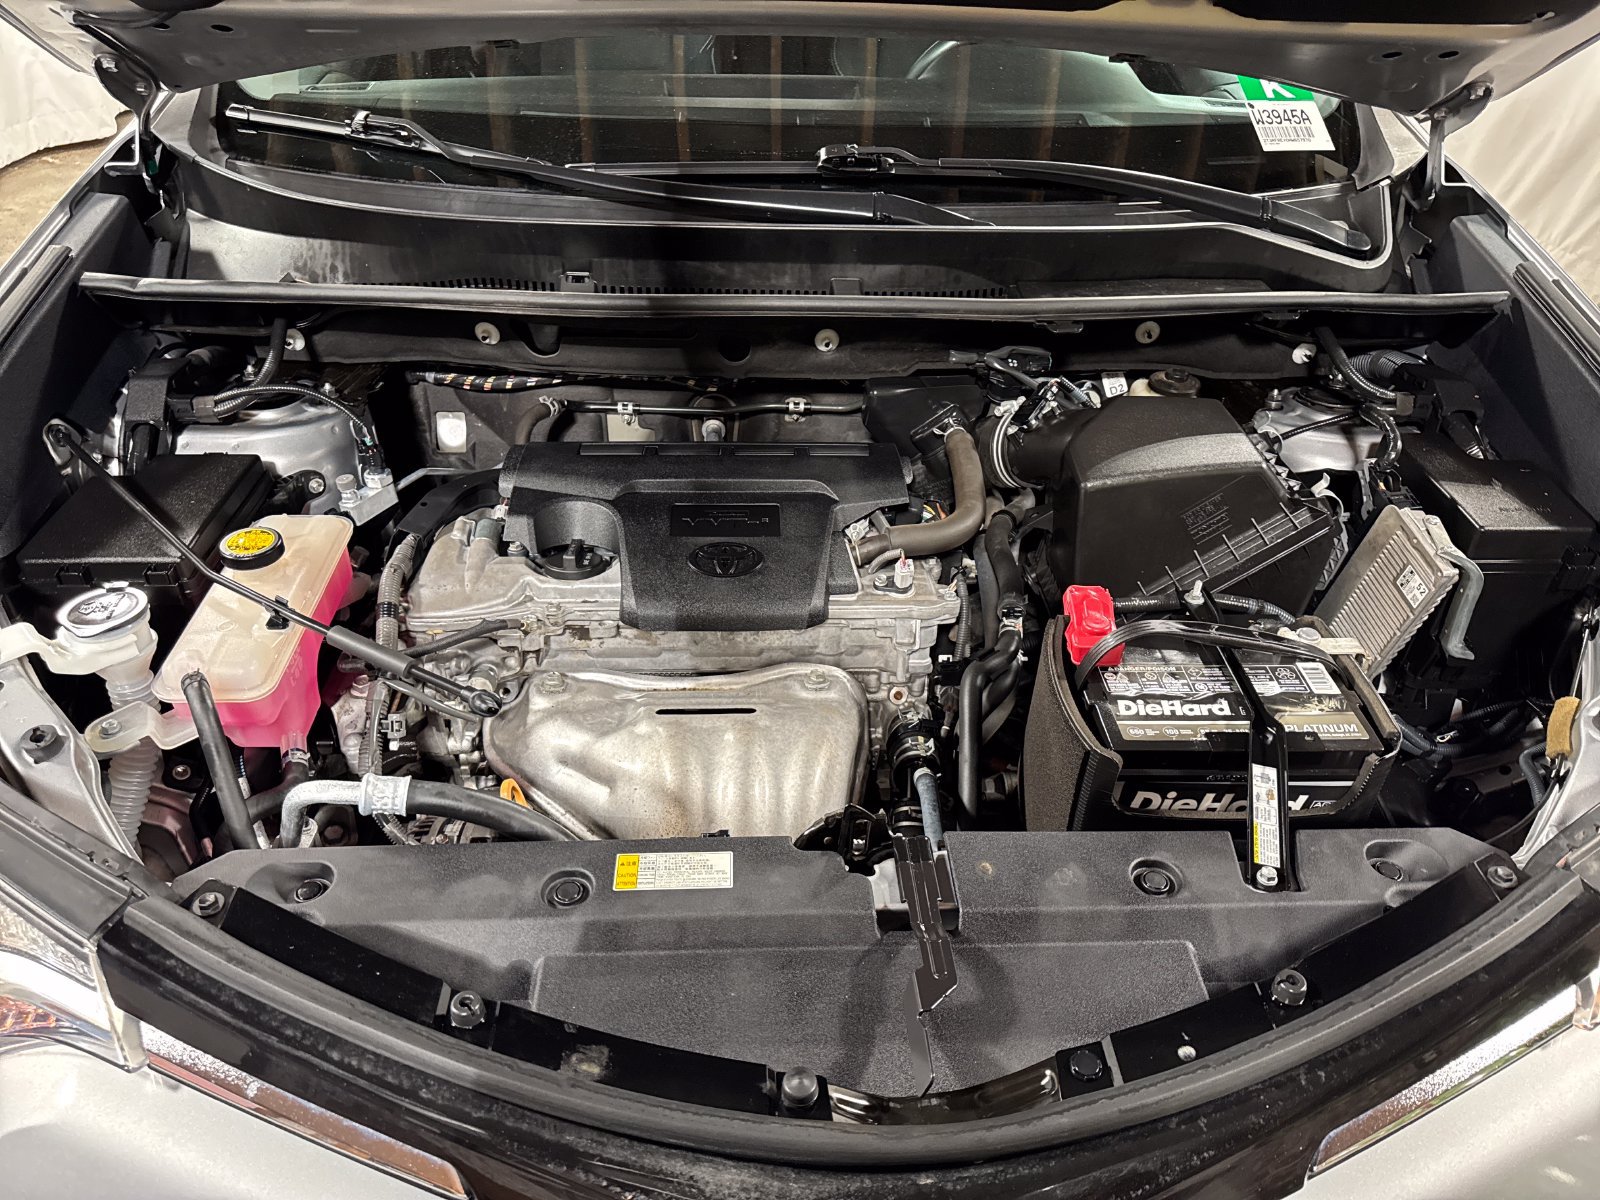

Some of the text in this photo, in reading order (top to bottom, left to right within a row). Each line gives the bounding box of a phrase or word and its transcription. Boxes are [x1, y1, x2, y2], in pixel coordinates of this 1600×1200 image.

[1251, 109, 1312, 125] W3945A
[1110, 384, 1124, 395] D2
[1416, 582, 1427, 596] 52
[1117, 699, 1232, 716] DieHard
[1284, 723, 1359, 733] PLATINUM
